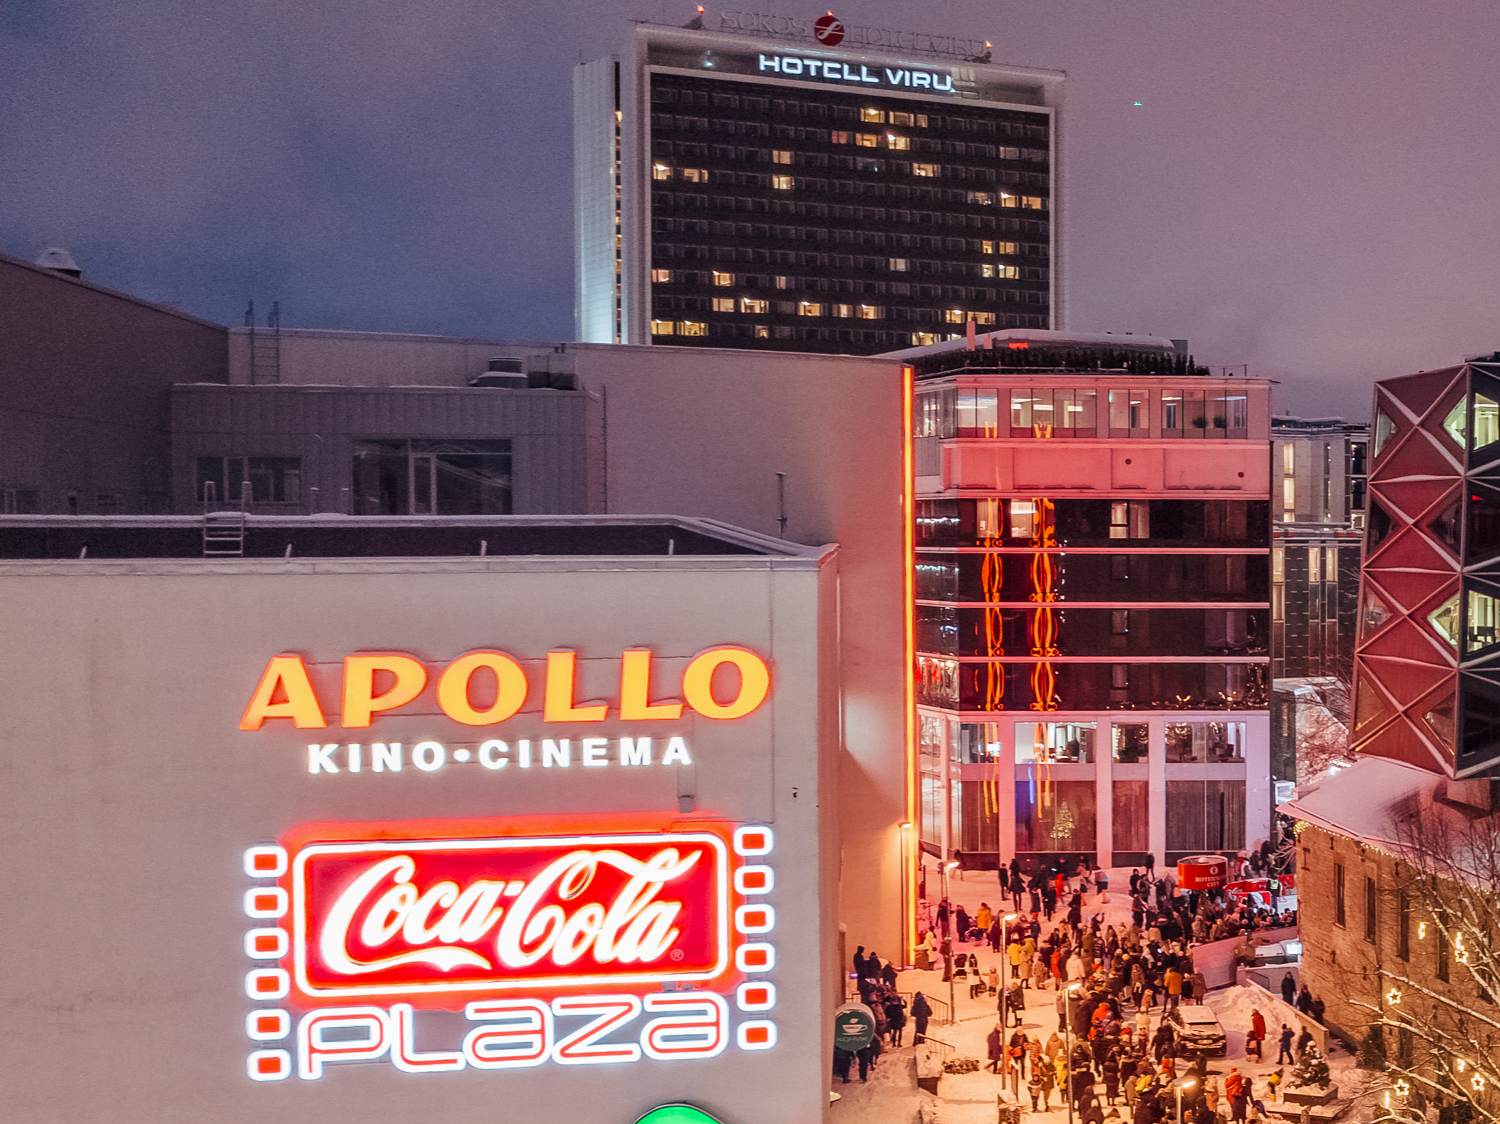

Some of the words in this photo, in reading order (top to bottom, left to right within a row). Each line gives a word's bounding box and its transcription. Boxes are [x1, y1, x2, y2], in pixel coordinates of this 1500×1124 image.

[758, 53, 880, 83] HOTELL
[885, 67, 953, 92] VIRU
[239, 645, 771, 731] APOLLO
[319, 846, 703, 976] Coca-Cola
